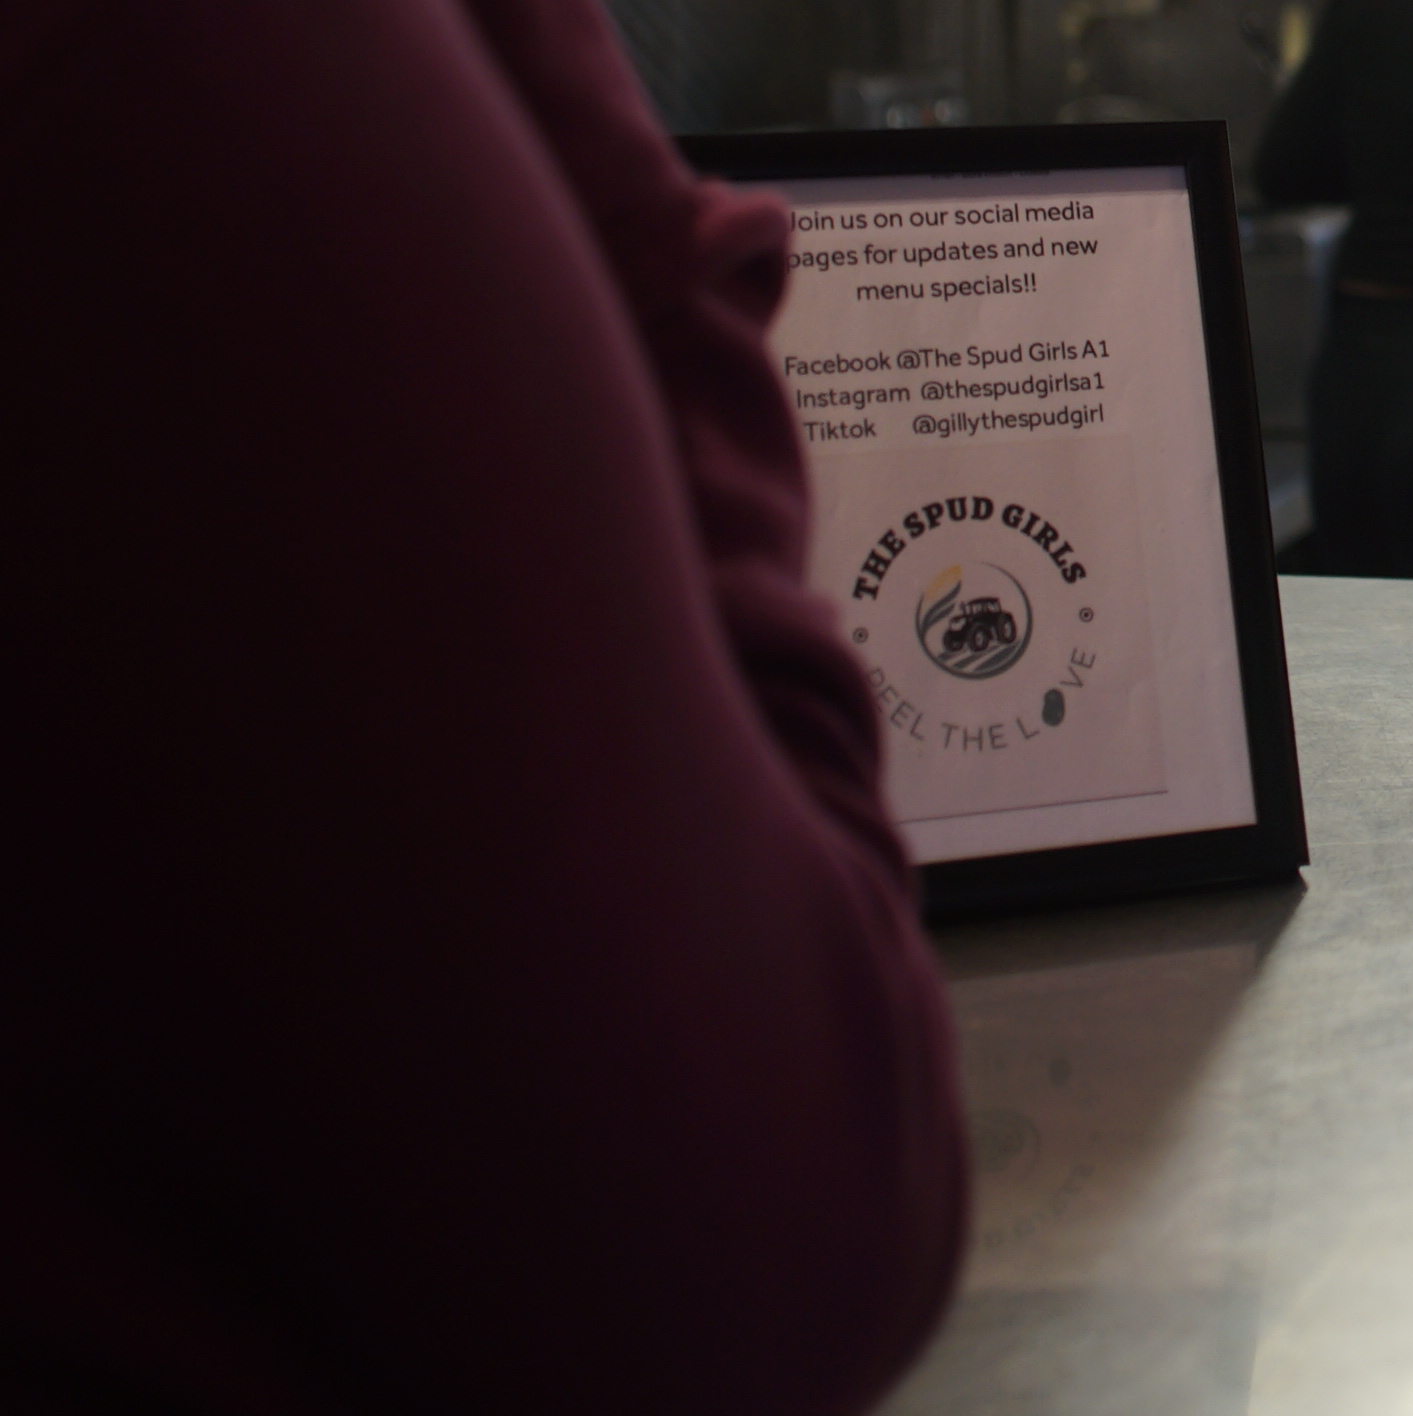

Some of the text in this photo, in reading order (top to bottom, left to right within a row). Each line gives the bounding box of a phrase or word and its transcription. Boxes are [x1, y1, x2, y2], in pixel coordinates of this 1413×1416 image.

[789, 201, 1095, 232] Join us on our social media
[786, 237, 1099, 273] pages for updates and new
[856, 273, 1038, 302] menu specials!!
[784, 339, 1111, 377] Facebook @The Spud Girls A1
[796, 372, 1106, 411] Instagram @thespudgirlsa1
[803, 403, 1106, 443] Tiktok @gillythespudgirl
[852, 495, 1088, 601] THE SPUD GIRLS
[940, 721, 1009, 753] THE
